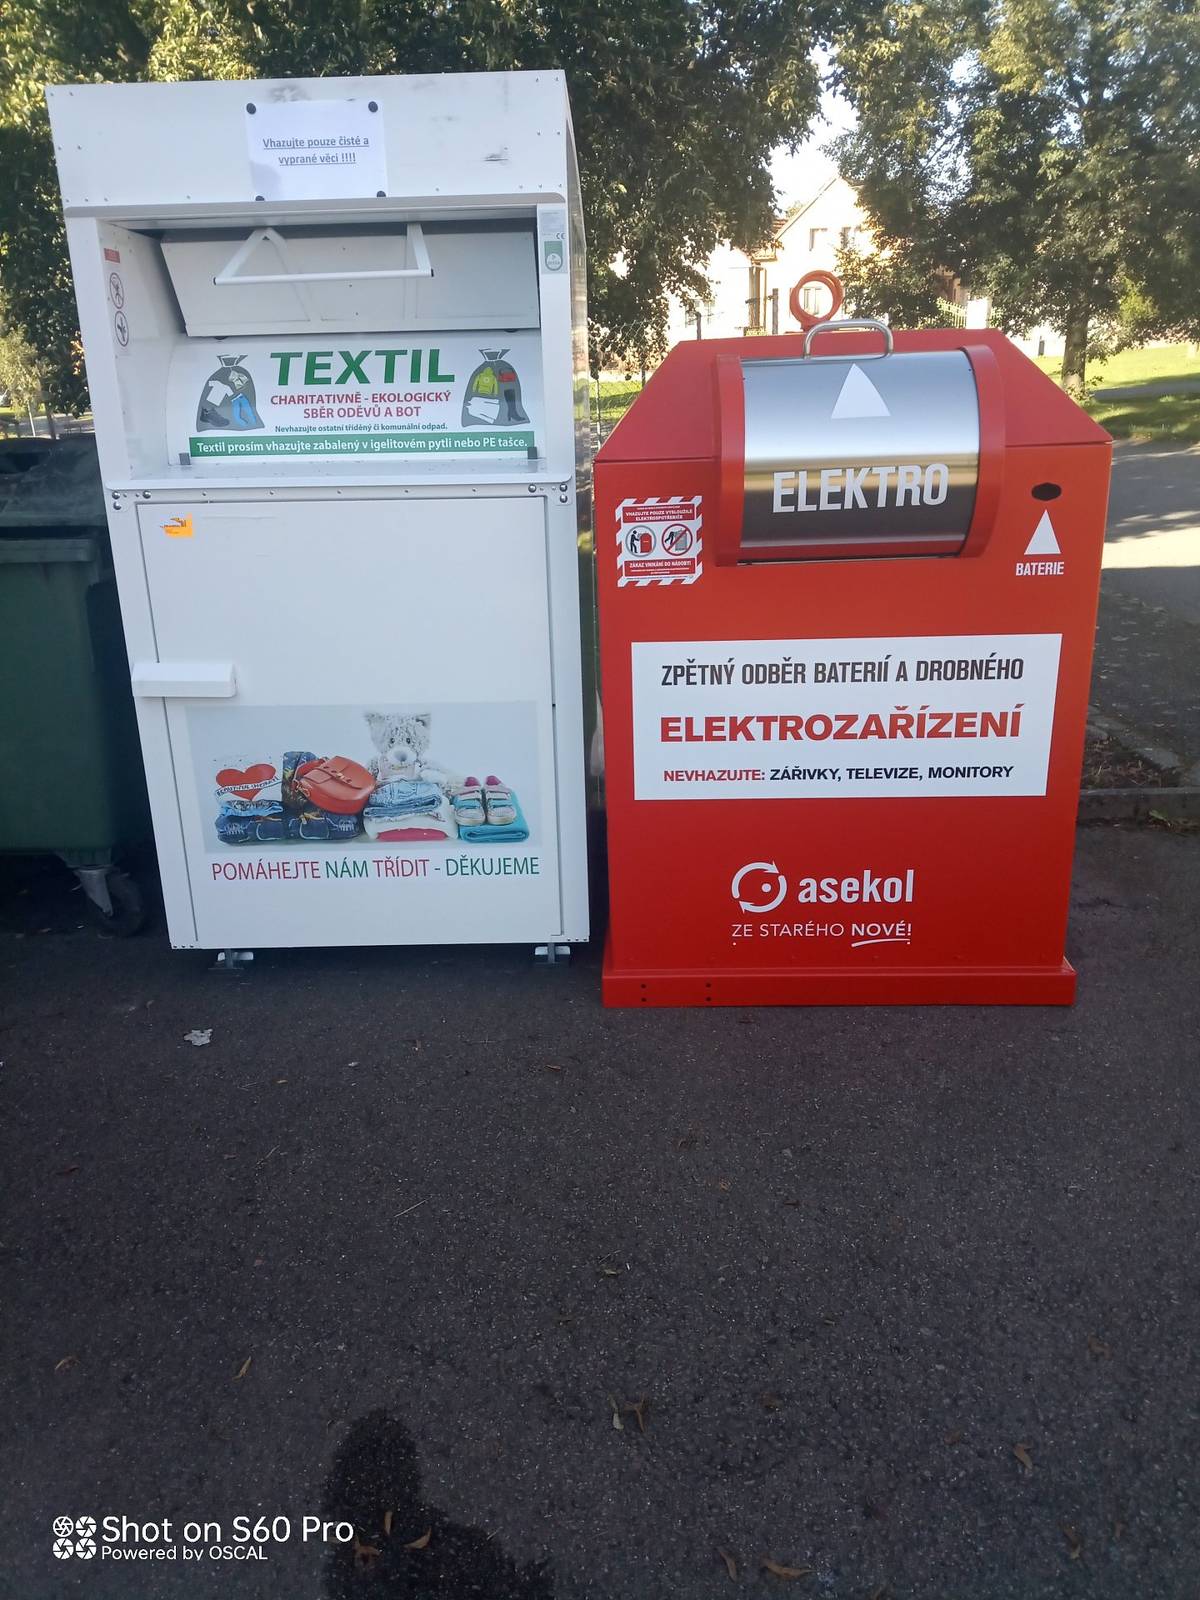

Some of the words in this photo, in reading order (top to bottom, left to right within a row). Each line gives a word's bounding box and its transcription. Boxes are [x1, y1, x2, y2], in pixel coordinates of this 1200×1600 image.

[262, 137, 305, 149] Vhazujte
[307, 138, 336, 148] pouze
[339, 135, 361, 146] čisté
[363, 137, 369, 145] a
[278, 153, 318, 165] vyprané
[320, 153, 339, 163] věci
[341, 152, 356, 162] !!!!
[270, 349, 455, 386] TEXTIL
[270, 392, 362, 405] CHARITATIVNĚ
[371, 391, 451, 403] EKOLOGICKÝ
[303, 405, 334, 419] SBĚR
[337, 404, 381, 418] ODĚVŮ
[384, 407, 393, 417] A
[396, 407, 421, 417] BOT
[275, 424, 317, 433] Nevhazujte
[318, 424, 344, 432] ostatní
[345, 423, 372, 433] tříděný
[373, 423, 380, 431] či
[381, 422, 421, 431] komunální
[422, 422, 448, 432] odpad.
[197, 442, 226, 453] Textil
[228, 440, 264, 454] prosím
[266, 440, 311, 453] vhazujte
[313, 439, 360, 452] zabalený
[370, 438, 426, 451] igelitovém
[428, 438, 451, 451] pytli
[454, 437, 481, 448] nebo
[483, 437, 496, 447] PE
[498, 437, 528, 448] tašce.
[772, 463, 949, 513] ELEKTRO
[1015, 561, 1065, 576] BATERIE
[661, 657, 735, 686] ZPĚTNÝ
[741, 656, 807, 685] ODBĚR
[814, 654, 893, 684] BATERIÍ
[895, 660, 909, 682] A
[915, 652, 1025, 682] DROBNÉHO
[660, 703, 1026, 743] ELEKTROZAŘÍZENÍ
[663, 769, 766, 782] NEVHAZUJTE:
[769, 765, 842, 782] ZÁŘIVKY,
[846, 766, 923, 781] TELEVIZE,
[928, 766, 1015, 779] MONITORY
[212, 858, 321, 881] POMÁHEJTE
[325, 856, 369, 879] NÁM
[372, 855, 430, 878] TŘÍDIT
[445, 854, 540, 876] DĚKUJEME
[797, 869, 915, 904] asekol
[731, 924, 753, 937] ZE
[759, 921, 845, 937] STARÉHO
[851, 920, 912, 937] NOVÉ!
